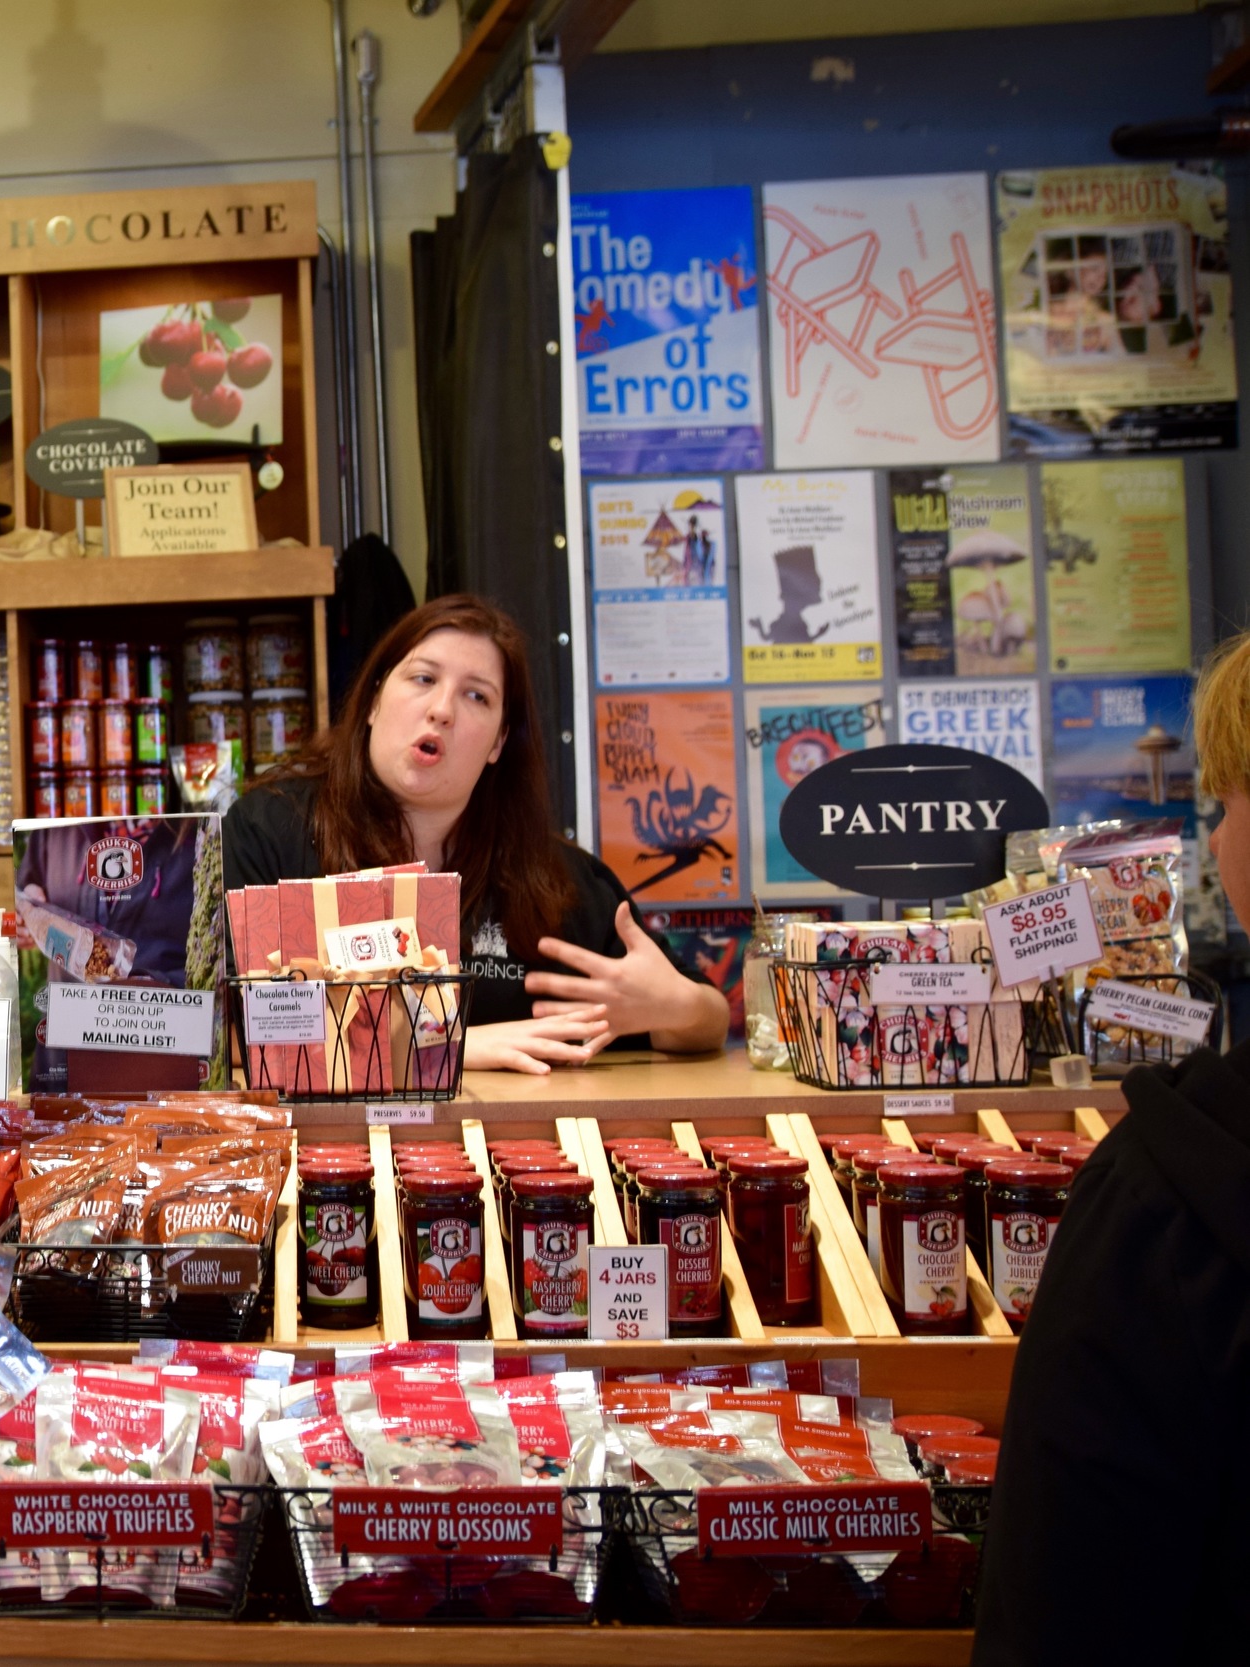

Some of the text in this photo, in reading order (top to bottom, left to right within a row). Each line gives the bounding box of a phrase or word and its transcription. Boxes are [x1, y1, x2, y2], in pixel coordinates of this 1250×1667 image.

[1041, 178, 1180, 217] SNAPSHOTS
[571, 224, 652, 272] The
[573, 258, 731, 316] omedy
[665, 322, 711, 370] of
[585, 363, 750, 415] Errors
[36, 439, 147, 459] CHOCOLATE
[49, 455, 135, 473] COVERED
[125, 477, 230, 500] Join Our
[143, 502, 219, 520] Team!
[140, 525, 226, 540] Applications
[151, 540, 217, 551] Available
[931, 688, 1030, 707] DEMETRIOS
[746, 699, 887, 748] BRECHTFEST
[907, 708, 1030, 734] GREEK
[820, 799, 1007, 835] PANTRY
[91, 839, 138, 855] CHUKAR
[90, 873, 140, 889] CHERRIES
[1000, 886, 1072, 917] ASK ABOUT
[1011, 903, 1067, 933] $8.95
[1009, 919, 1077, 948] FLAT RATE
[1014, 932, 1078, 959] SHIPPING!
[912, 977, 952, 987] GREEN TEA
[60, 988, 87, 998] TAKE
[90, 990, 98, 999] A
[101, 990, 136, 1001] FREE
[140, 992, 202, 1005] CATALOG
[256, 987, 313, 999] Chocolate Cherry
[98, 1003, 164, 1016] OR SIGN UP
[269, 1002, 301, 1011] Caramels
[1095, 985, 1125, 1002] CHERRY
[1127, 993, 1151, 1008] PECAN
[1152, 1000, 1186, 1015] CARAMEL
[1188, 1008, 1210, 1021] CORN
[94, 1017, 166, 1030] TO JOIN OUR
[82, 1032, 176, 1047] MAILING LIST!
[887, 1100, 910, 1108] DESSERT
[373, 1110, 426, 1119] PRESERVES $9.50
[432, 1219, 468, 1230] CHUKAR
[611, 1257, 644, 1269] BUY
[678, 1257, 710, 1270] DESSERT
[918, 1253, 960, 1265] CHOCOLATE
[181, 1261, 220, 1276] CHUNKY
[308, 1265, 365, 1278] SWEET CHERRY
[676, 1270, 711, 1283] CHERRIES
[926, 1266, 955, 1277] CHERRY
[182, 1271, 241, 1285] CHERRY NUT
[599, 1270, 656, 1285] 4 JARS
[422, 1283, 479, 1297] SOUR CHERRY
[532, 1280, 582, 1294] RASPBERRY
[540, 1294, 575, 1307] CHERRY
[614, 1293, 642, 1303] AND
[608, 1308, 648, 1321] SAVE
[617, 1321, 639, 1339] $3
[15, 1493, 190, 1509] WHITE CHOCOLATE
[339, 1502, 556, 1515] MILK & WHITE CHOCOLATE
[728, 1497, 899, 1515] MILK CHOCOLATE
[12, 1509, 195, 1535] RASPBERRY TRUFFLES
[709, 1512, 920, 1541] CLASSIC MILK CHERRIES
[364, 1519, 531, 1543] CHERRY BLOSSOMS
